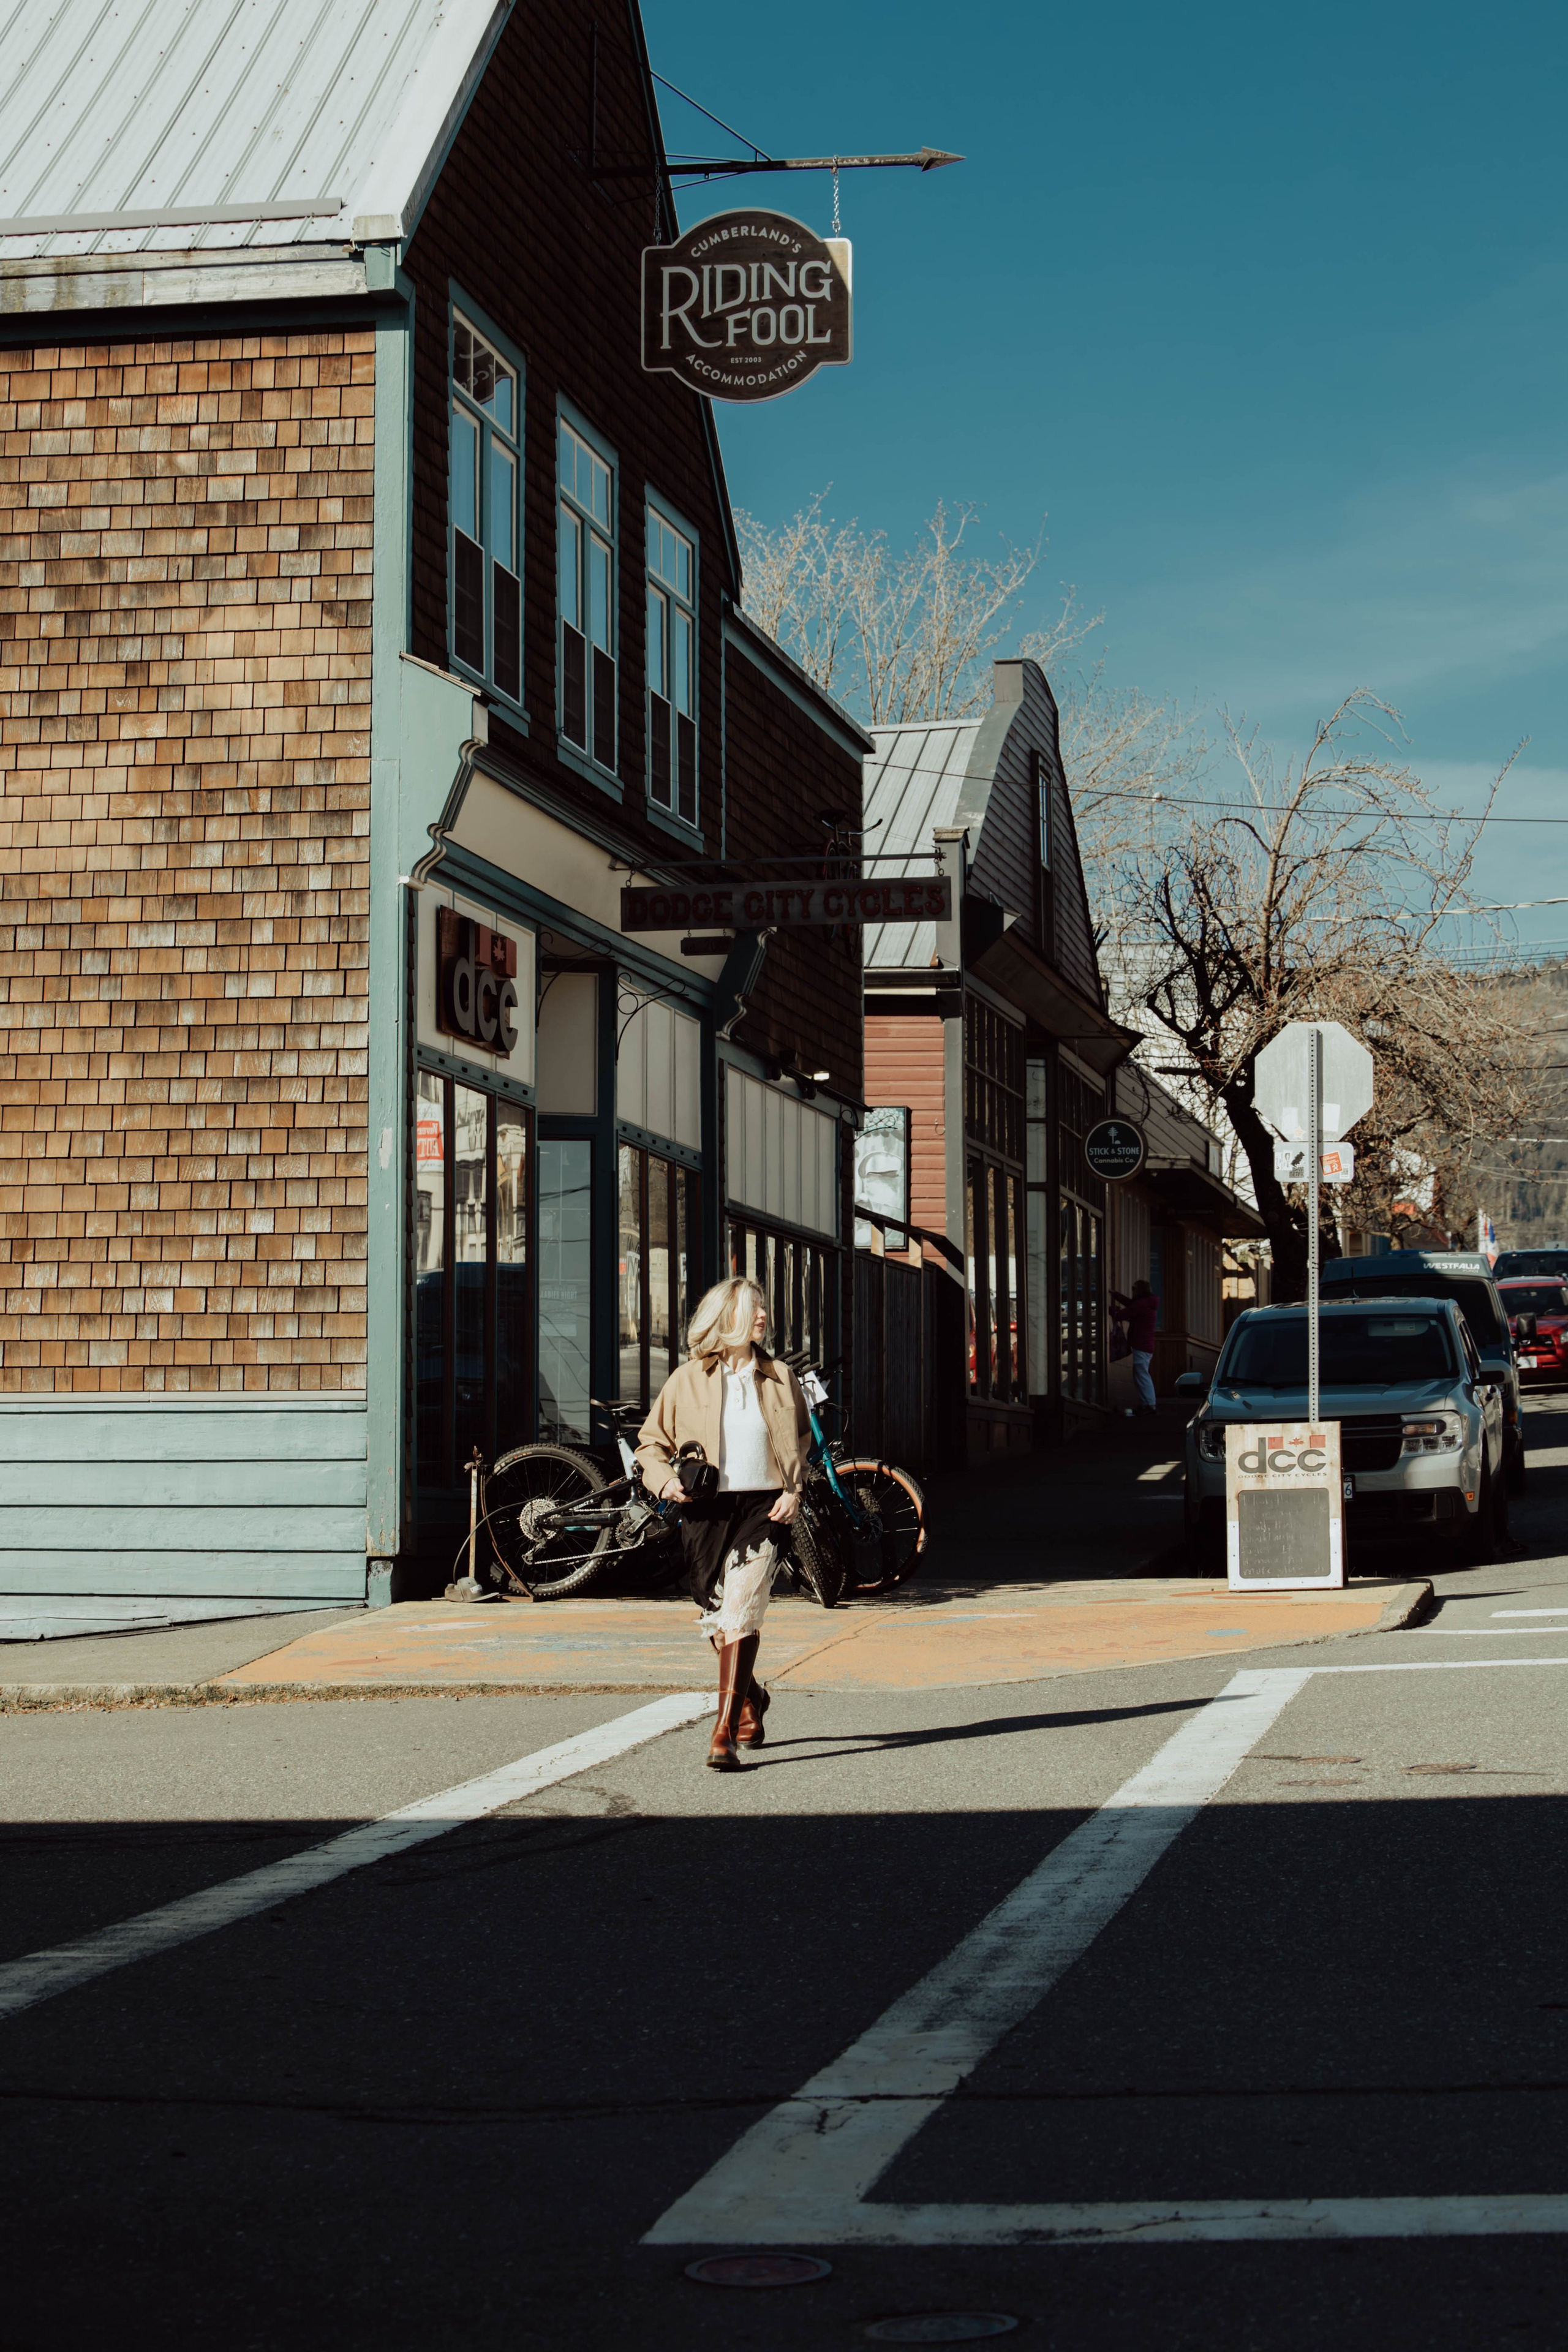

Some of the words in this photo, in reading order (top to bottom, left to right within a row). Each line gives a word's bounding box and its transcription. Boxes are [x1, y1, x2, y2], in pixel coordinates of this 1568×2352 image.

[690, 225, 802, 258] CUMBERLAND'S
[660, 260, 833, 349] RIDING
[725, 304, 831, 347] FOOL
[685, 350, 807, 386] ACCOMMODATION
[628, 892, 733, 924] DODGE
[744, 889, 814, 919] CITY
[823, 885, 945, 917] CYCLES
[453, 918, 518, 1052] dcc
[1238, 1437, 1326, 1474] dcc
